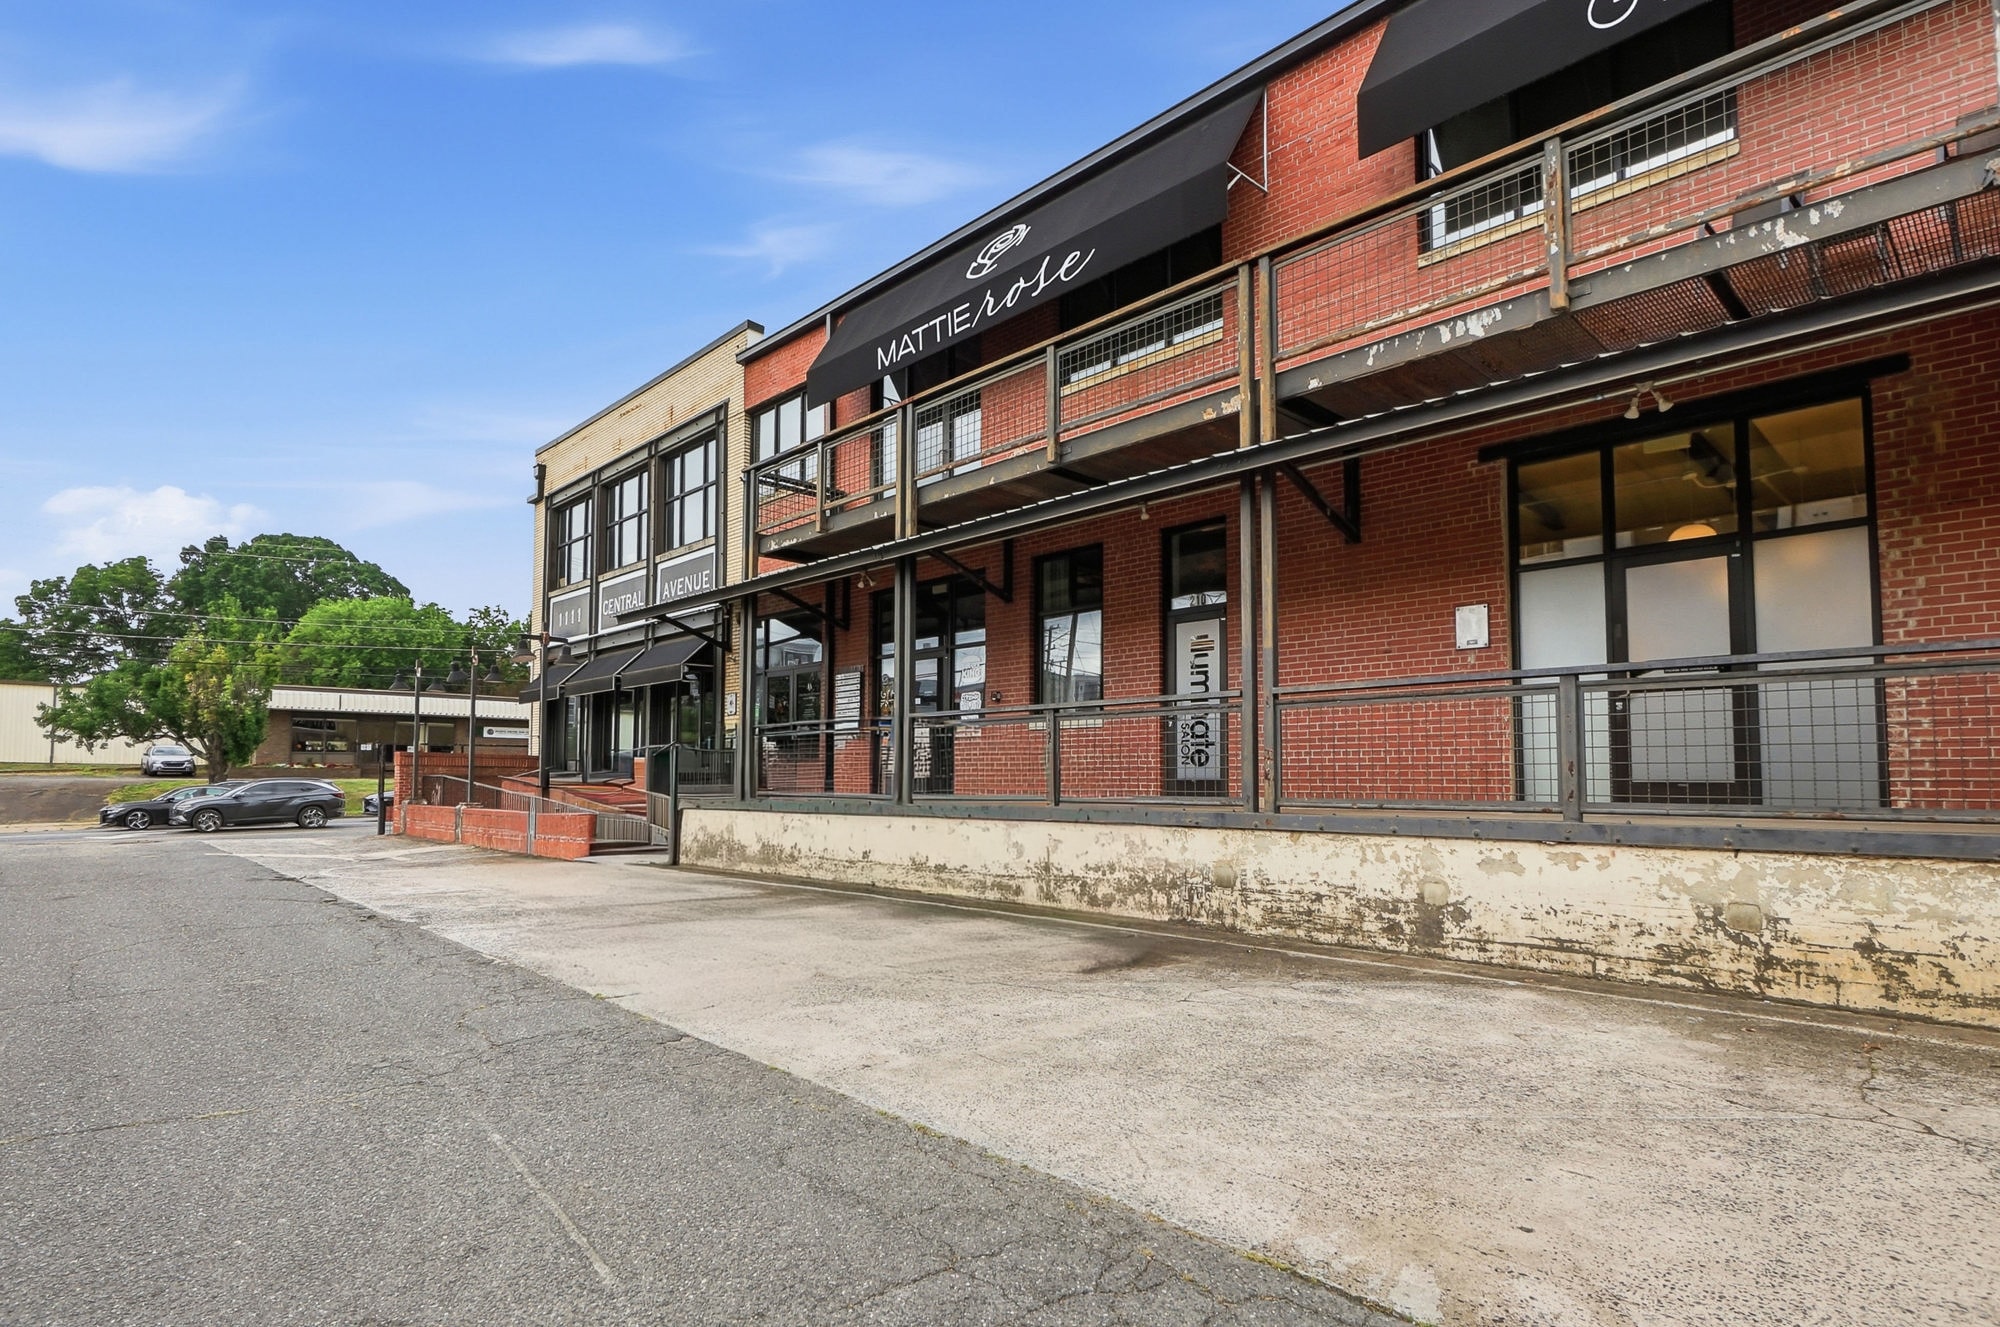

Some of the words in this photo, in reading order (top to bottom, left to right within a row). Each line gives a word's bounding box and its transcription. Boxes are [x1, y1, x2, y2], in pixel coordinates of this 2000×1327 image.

[877, 302, 972, 370] MATTIE
[971, 248, 1096, 328] rose
[558, 607, 581, 627] 1111
[602, 590, 645, 615] CENTRAL
[662, 569, 711, 600] AVENUE
[1189, 593, 1207, 607] 210
[1180, 722, 1191, 766] SALON
